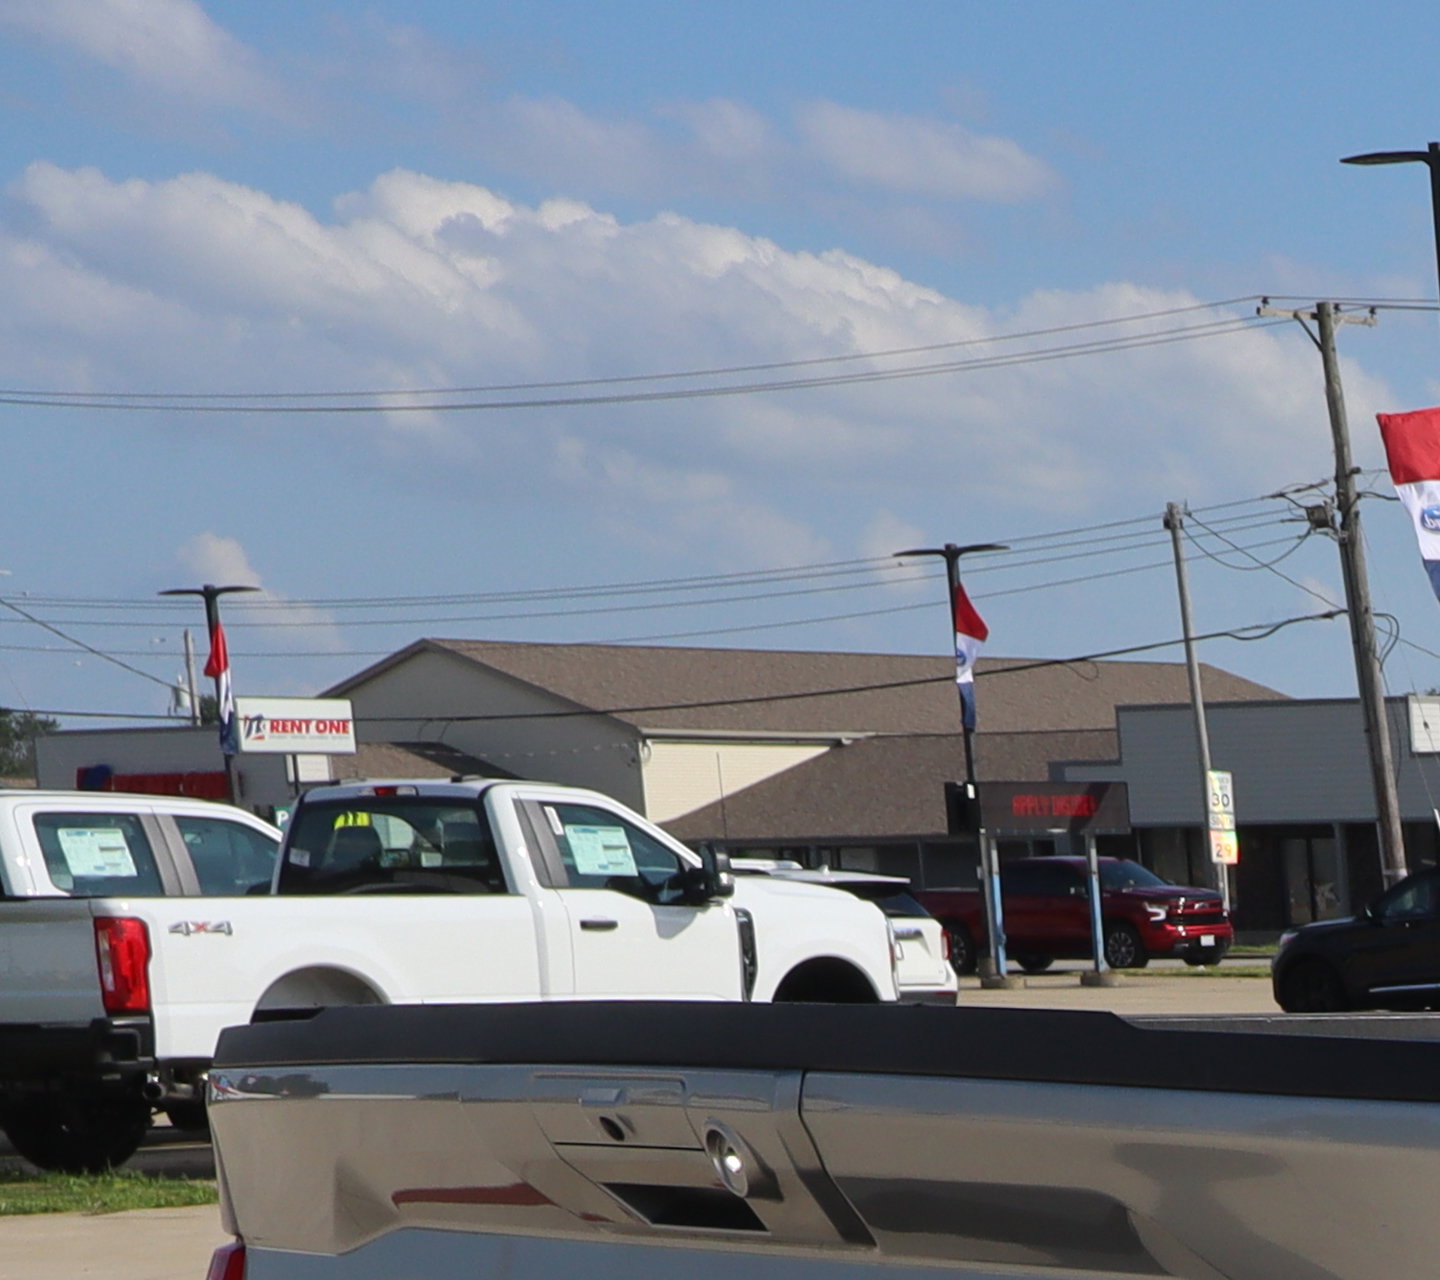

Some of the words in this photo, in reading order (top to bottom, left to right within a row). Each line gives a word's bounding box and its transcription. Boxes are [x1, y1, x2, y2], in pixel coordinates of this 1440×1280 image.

[269, 718, 312, 734] RENT
[315, 718, 350, 734] ONE
[1211, 792, 1230, 807] 30
[1215, 843, 1233, 858] 29
